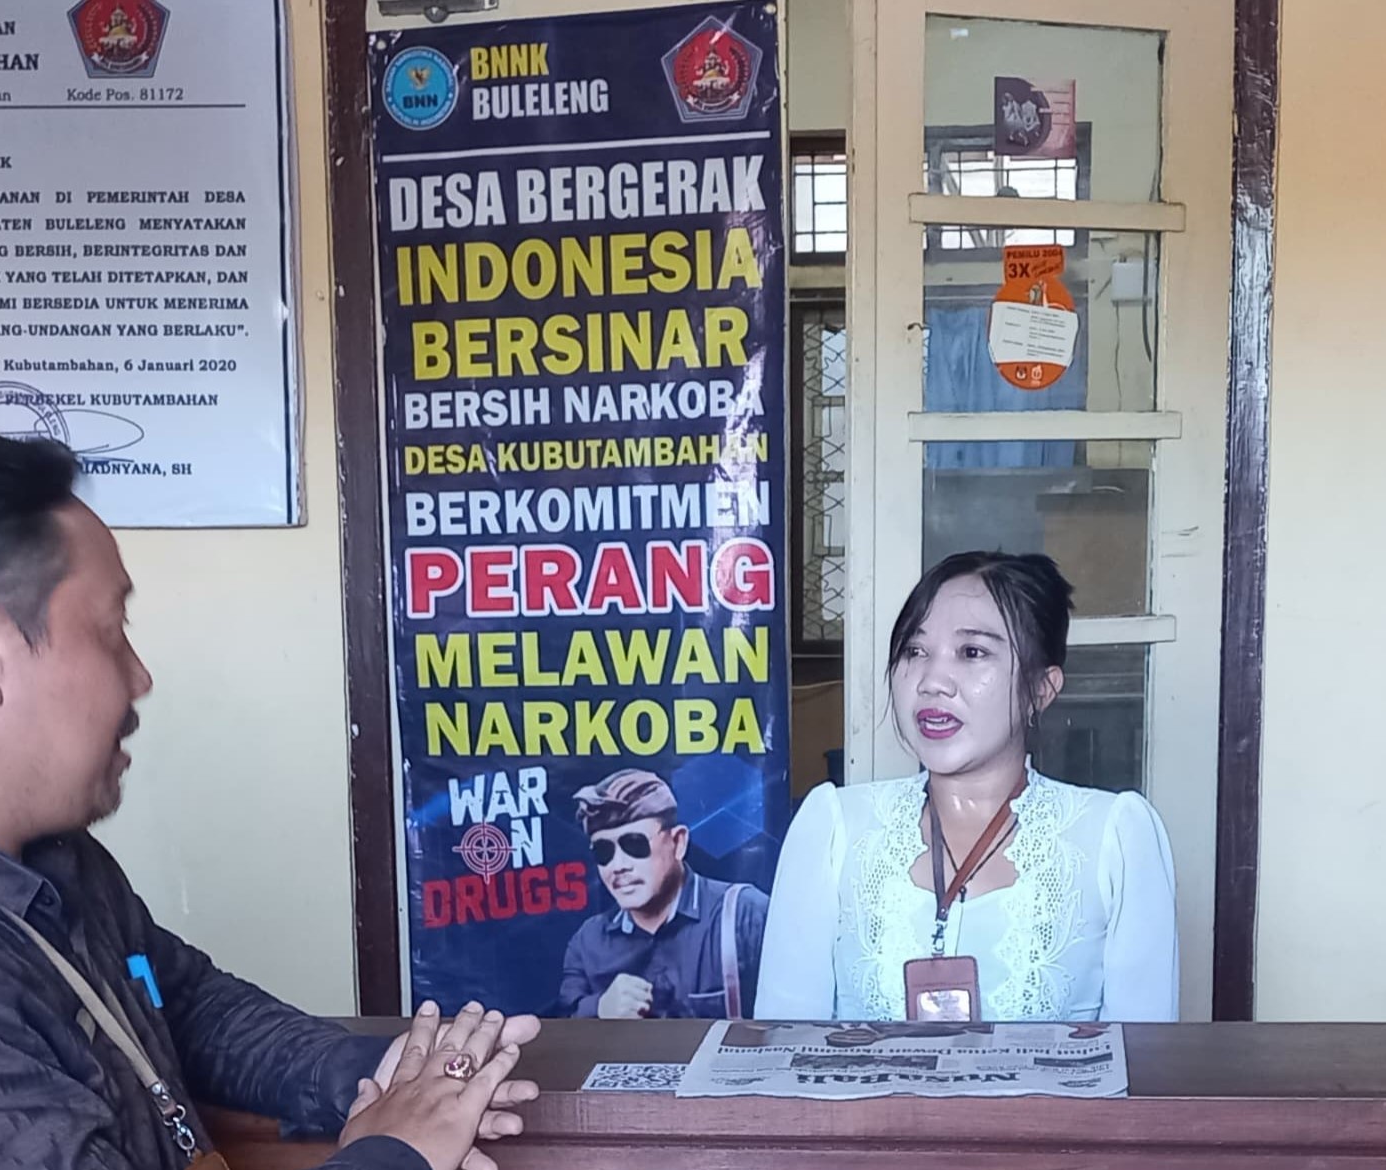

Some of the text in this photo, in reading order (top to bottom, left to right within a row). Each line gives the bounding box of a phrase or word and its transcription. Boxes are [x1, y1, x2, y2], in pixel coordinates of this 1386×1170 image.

[470, 43, 549, 81] BNNK
[67, 87, 184, 102] Kode Pos. 81172
[472, 78, 609, 120] BULELENG
[56, 191, 72, 204] DI
[87, 191, 190, 204] PEMERINTAH
[205, 191, 246, 204] DESA
[388, 154, 767, 232] DESA BERGERAK
[45, 218, 127, 231] BULELENG
[139, 217, 247, 231] MENYATAKAN
[14, 245, 78, 260] BERSIH,
[83, 244, 210, 258] BERINTEGRITAS
[215, 244, 247, 258] DAN
[396, 226, 762, 306] INDONESIA
[1008, 263, 1030, 279] 3X
[5, 271, 47, 284] YANG
[52, 271, 102, 284] TELAH
[107, 271, 212, 286] DITETAPKAN,
[217, 270, 248, 284] DAN
[22, 297, 100, 310] BERSEDIA
[105, 297, 158, 310] UNTUK
[164, 297, 249, 310] MENERIMA
[116, 324, 158, 337] YANG
[411, 306, 749, 381] BERSINAR
[3, 358, 237, 373] Kubutambahan, 6 Januari 2020
[5, 393, 218, 406] PERBEKEL KUBUTAMBAHAN
[403, 378, 765, 430] BERSIH NARKOBA
[80, 462, 192, 477] IADNYANA, SH
[404, 431, 768, 475] DESA KUBUTAMBAHAN
[405, 480, 770, 536] BERKOMITMEN
[404, 537, 775, 619] PERANG
[415, 625, 769, 689] MELAWAN
[424, 697, 767, 758] NARKOBA
[448, 766, 549, 827] WAR
[423, 860, 588, 929] DRUGS
[797, 1072, 1021, 1084] NusaBali
